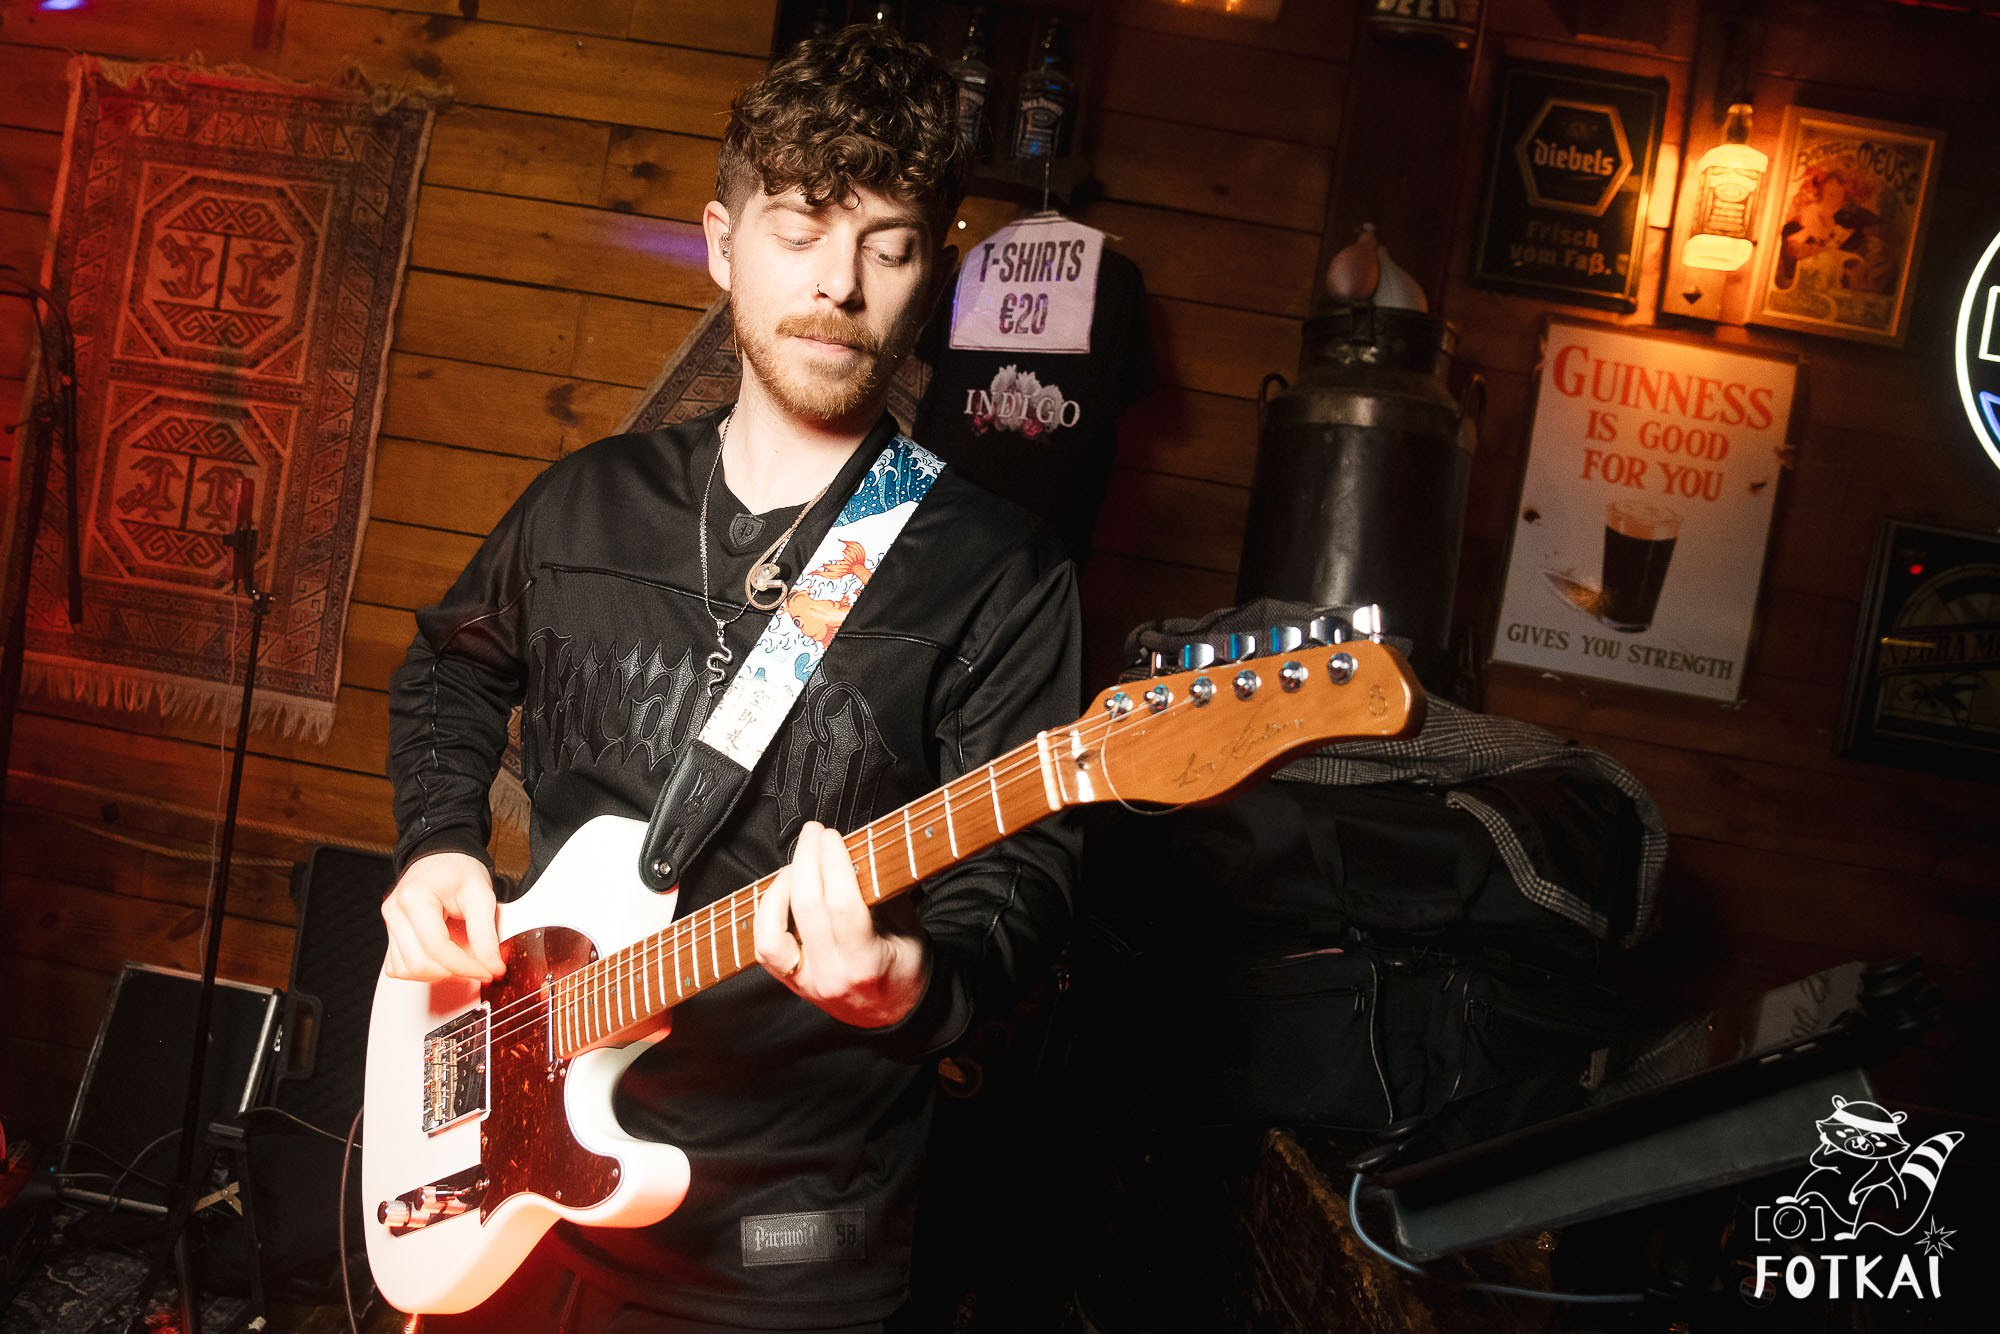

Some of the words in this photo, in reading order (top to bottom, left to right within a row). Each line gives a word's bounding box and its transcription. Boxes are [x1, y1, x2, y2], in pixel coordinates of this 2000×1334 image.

[1533, 138, 1614, 176] Diebels
[1526, 219, 1599, 249] Frisch
[979, 239, 1085, 283] T-SHIRTS
[999, 292, 1048, 335] €20
[963, 388, 1081, 428] INDIGO
[1552, 344, 1774, 430] GUINNESS
[1584, 410, 1618, 441] IS
[1639, 421, 1730, 461] GOOD
[1580, 450, 1647, 489] FOR
[1656, 461, 1724, 500] YOU
[1507, 624, 1570, 650] GIVES
[1581, 635, 1622, 660] YOU
[1627, 644, 1733, 680] STRENGTH
